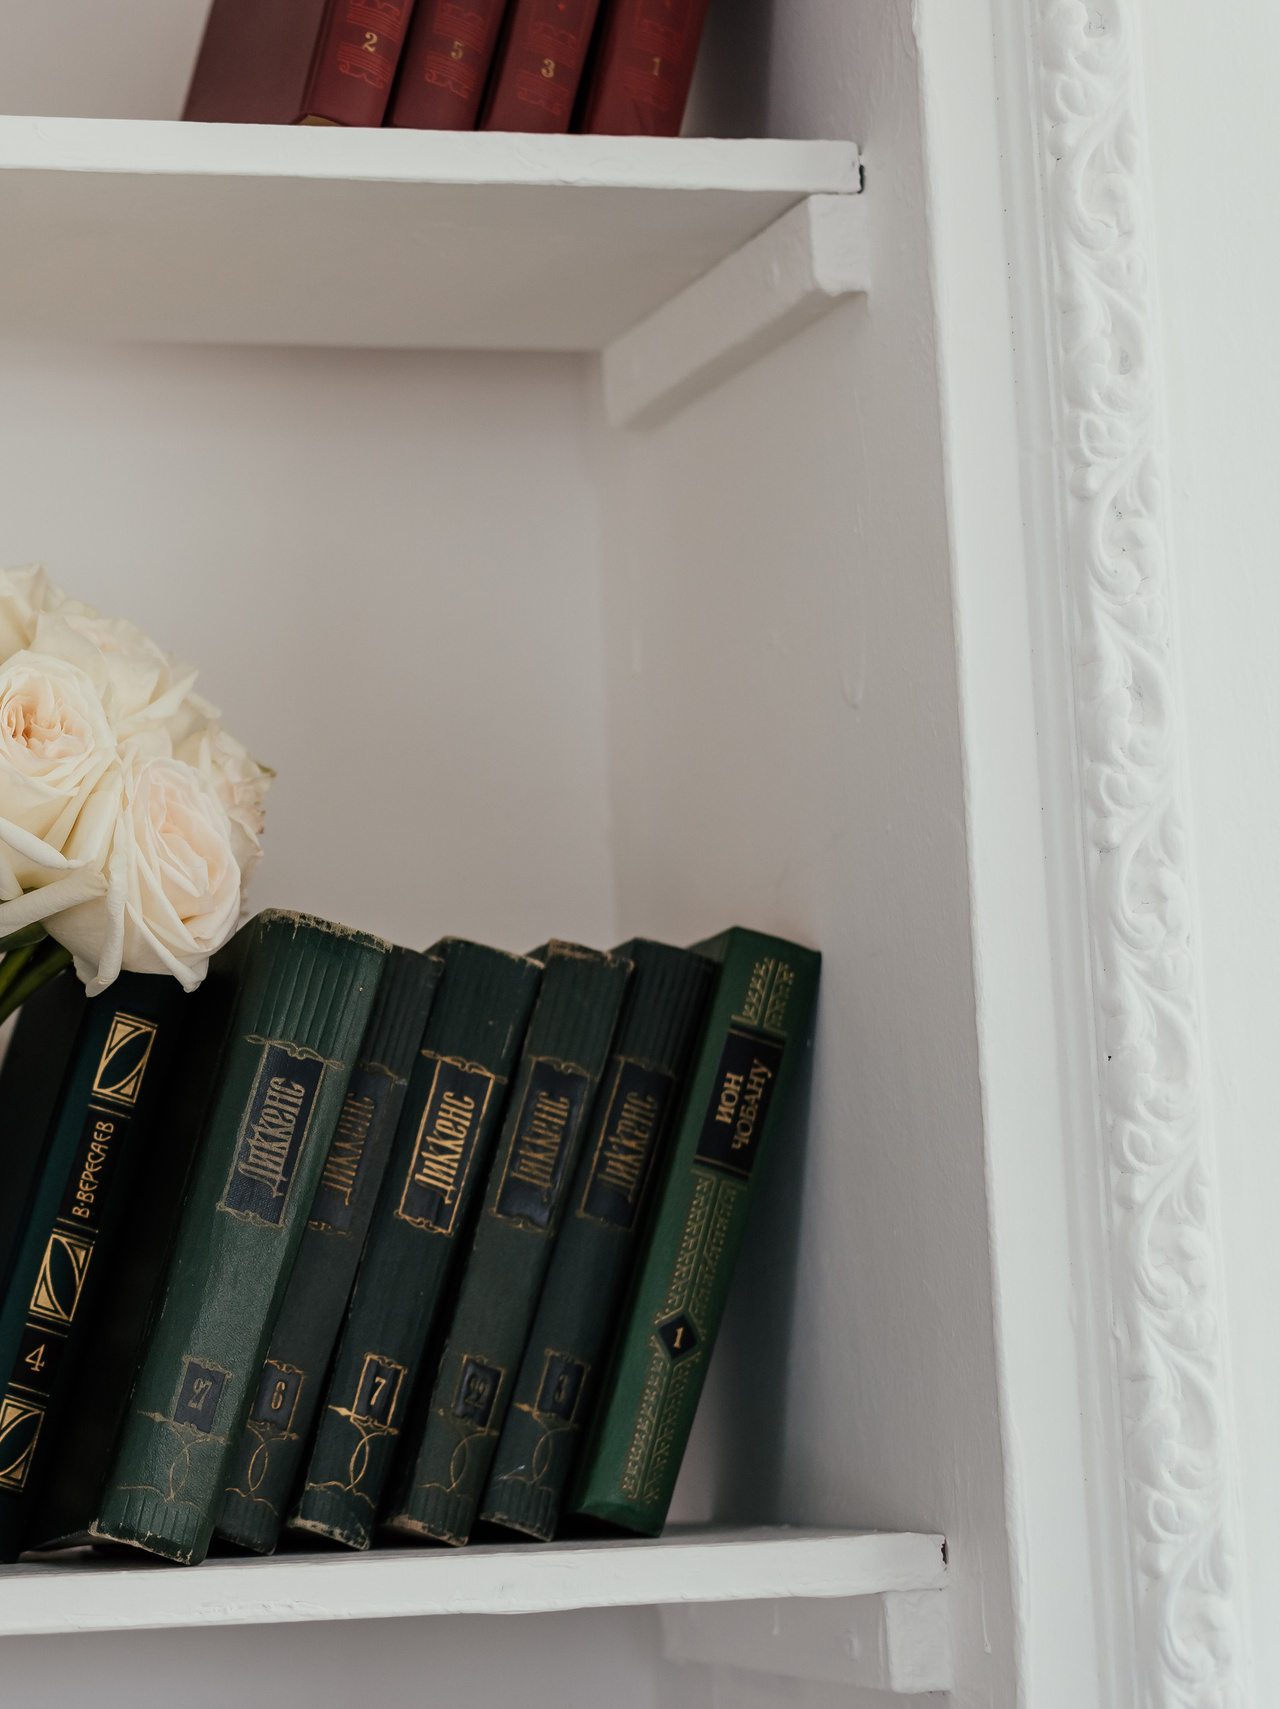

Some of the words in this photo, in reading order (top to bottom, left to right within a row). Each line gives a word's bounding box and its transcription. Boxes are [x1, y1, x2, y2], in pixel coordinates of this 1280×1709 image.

[363, 32, 377, 53] 2
[451, 40, 465, 60] 5
[541, 58, 556, 78] 3
[651, 57, 661, 76] 1
[715, 1072, 744, 1124] ИОН
[731, 1058, 772, 1150] ЧОБАНУ
[673, 1327, 684, 1348] 1
[25, 1344, 45, 1372] 4
[271, 1381, 286, 1410] 6
[370, 1376, 387, 1406] 7
[554, 1374, 569, 1403] 3
